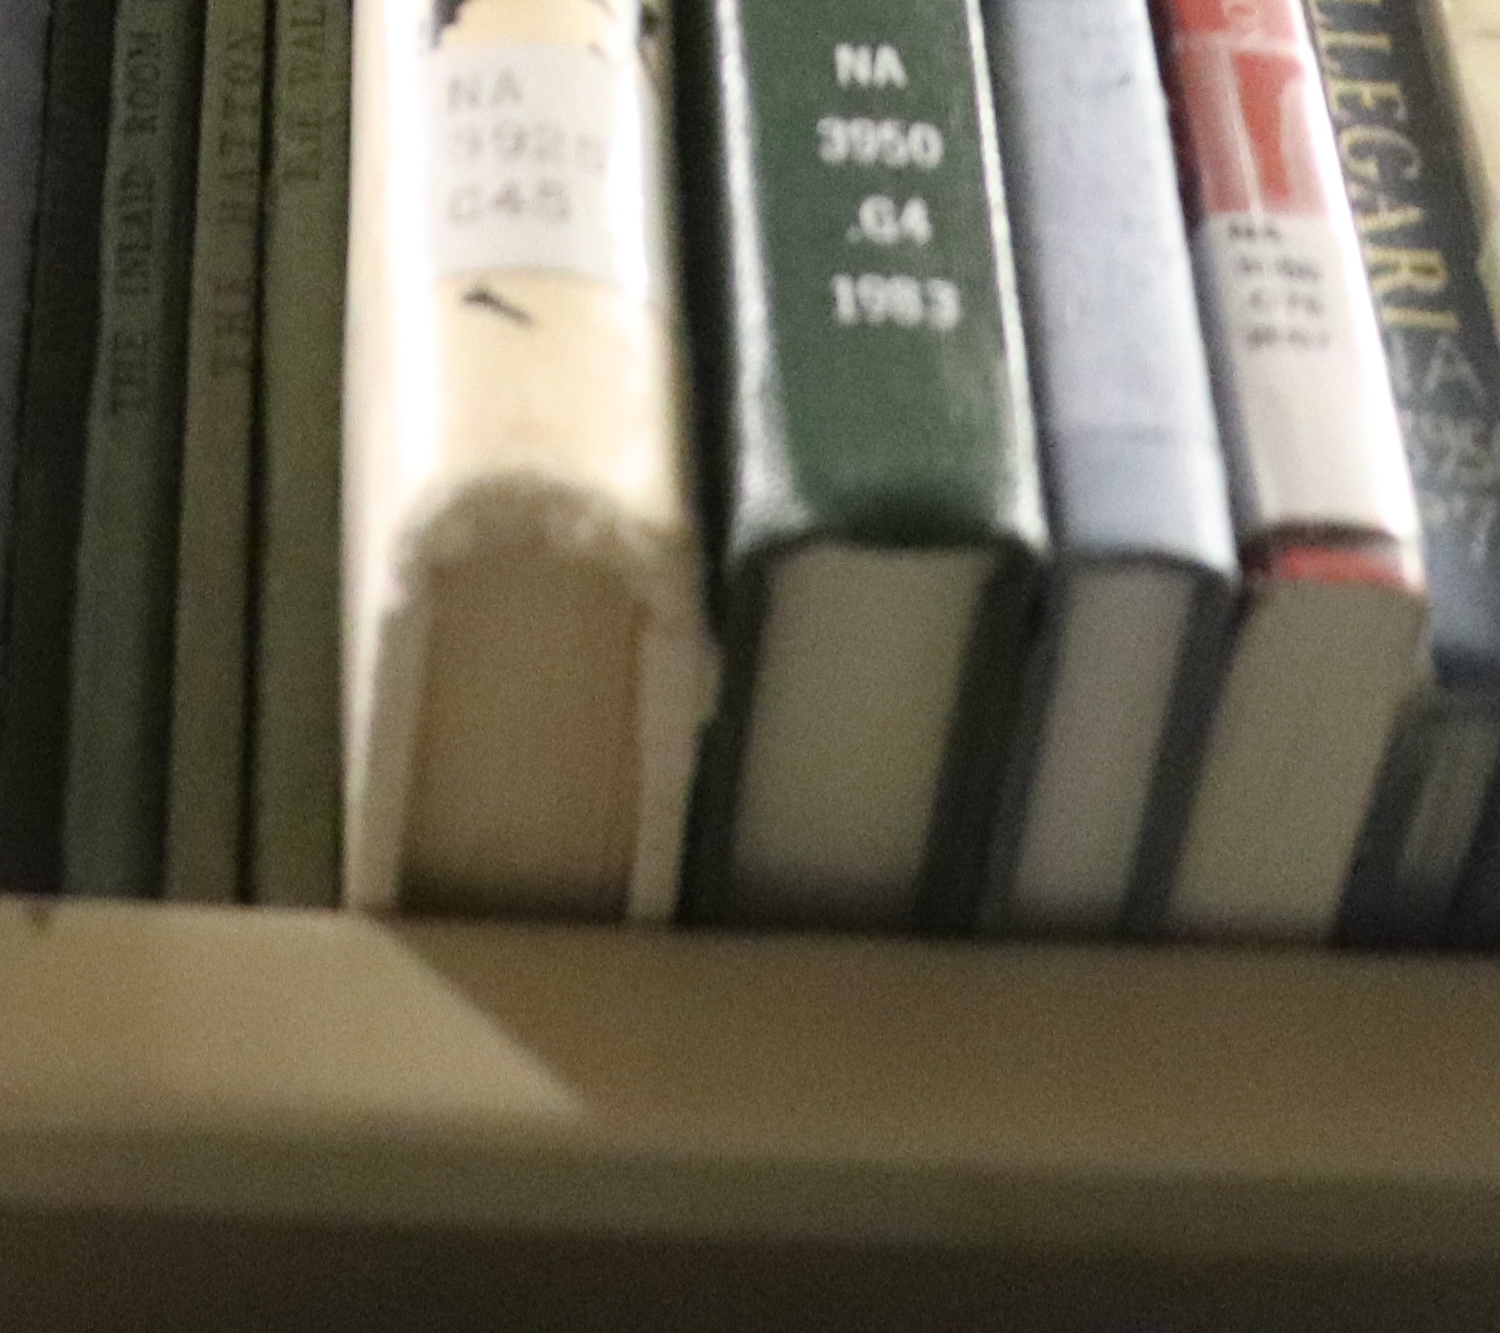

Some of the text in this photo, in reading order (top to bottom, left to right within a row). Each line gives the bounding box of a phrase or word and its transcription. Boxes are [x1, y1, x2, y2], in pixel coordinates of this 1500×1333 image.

[833, 42, 908, 91] NA
[815, 116, 944, 170] 3950
[830, 272, 962, 332] 1983
